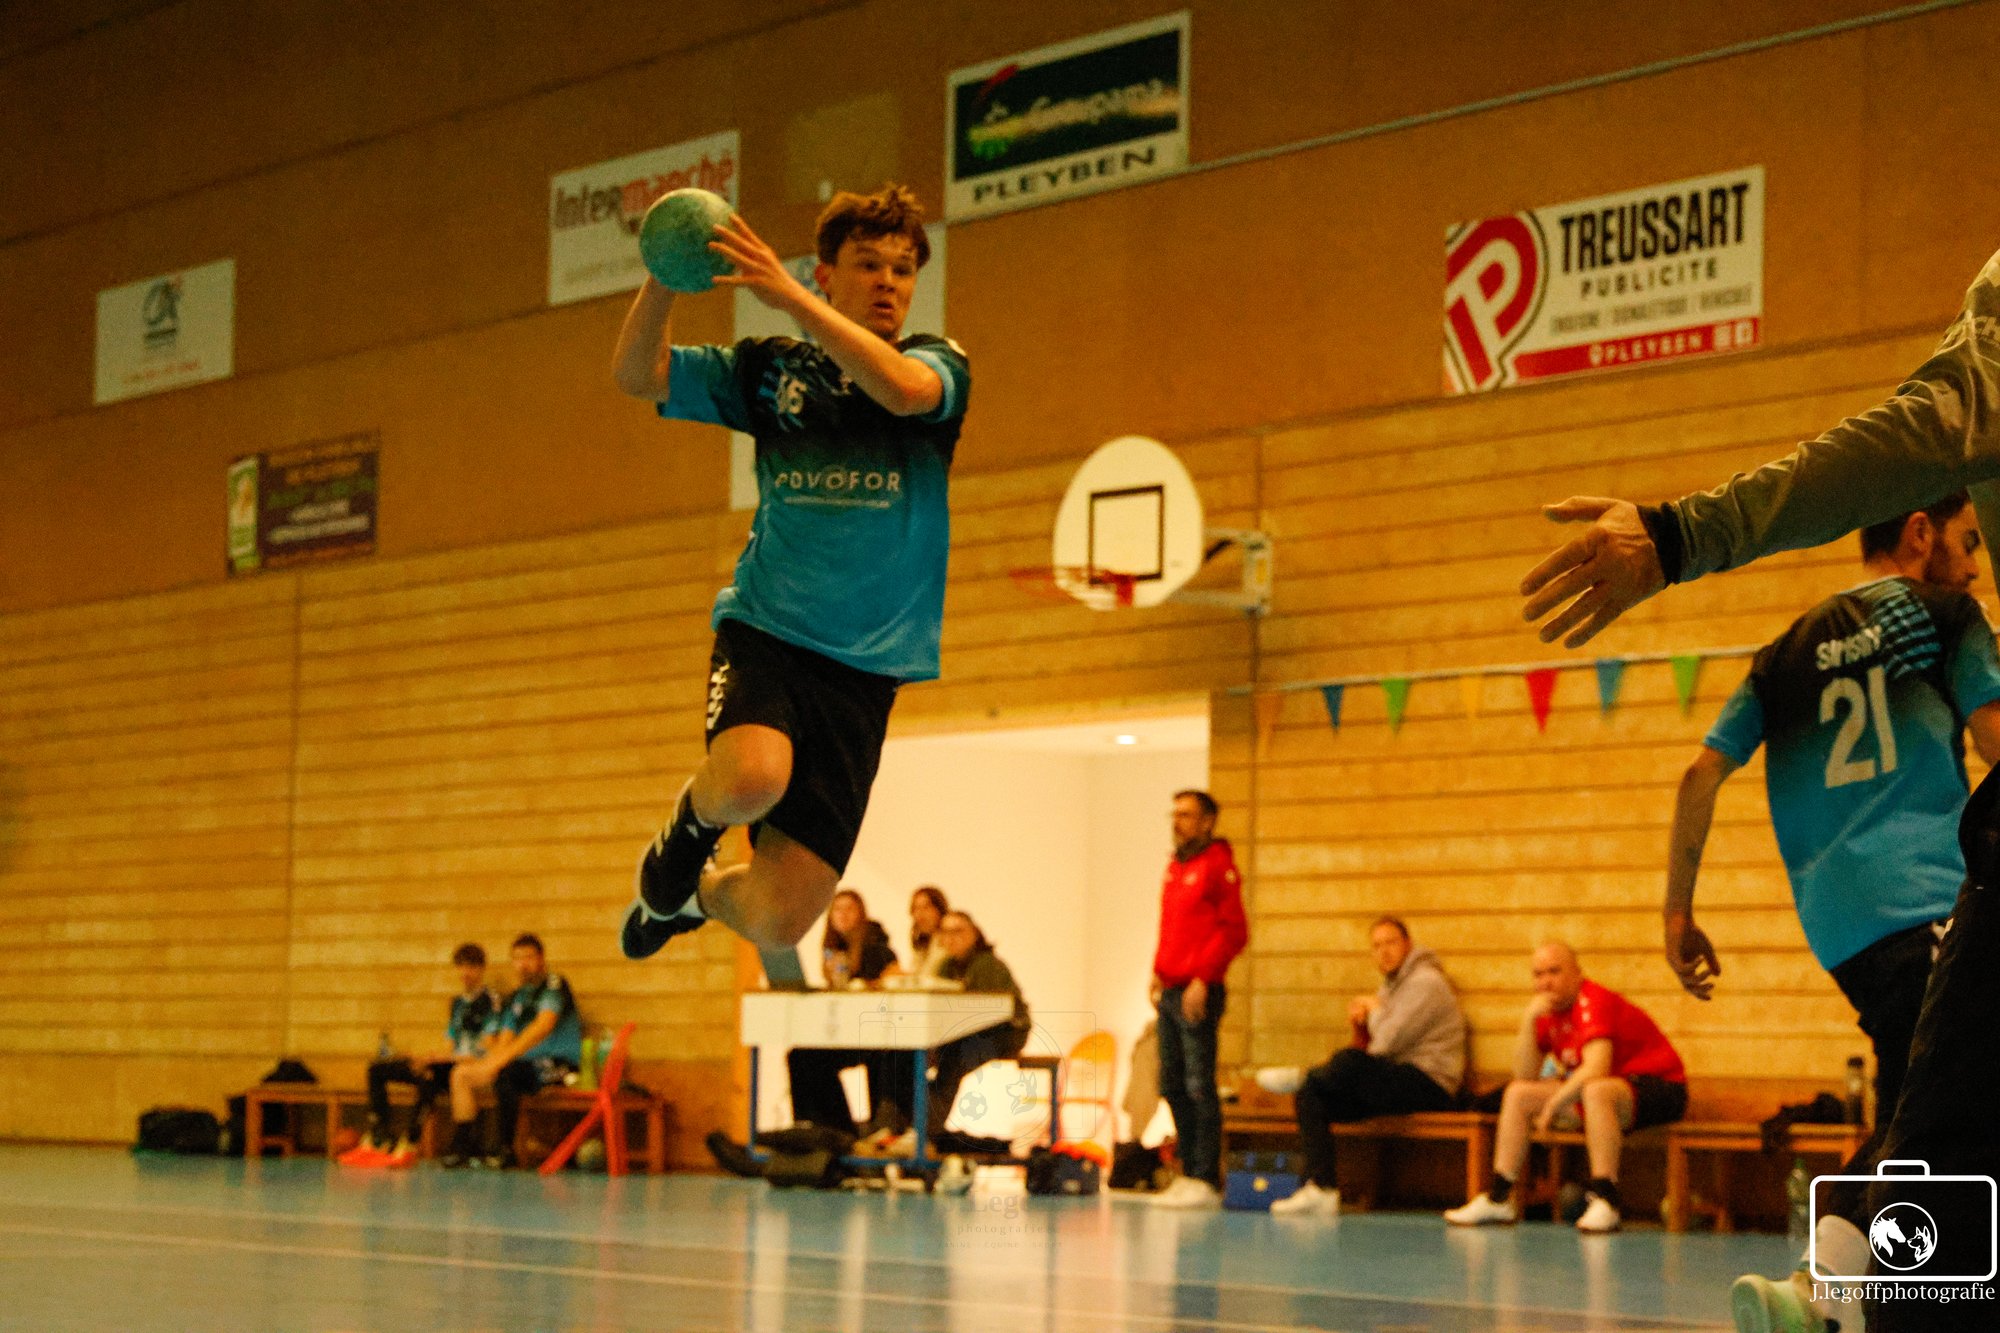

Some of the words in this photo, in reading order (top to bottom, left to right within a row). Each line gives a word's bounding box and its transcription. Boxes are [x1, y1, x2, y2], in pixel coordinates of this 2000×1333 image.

[973, 147, 1156, 202] PLEYBEN
[1559, 182, 1751, 275] TREUSSART
[1819, 664, 1898, 789] 21
